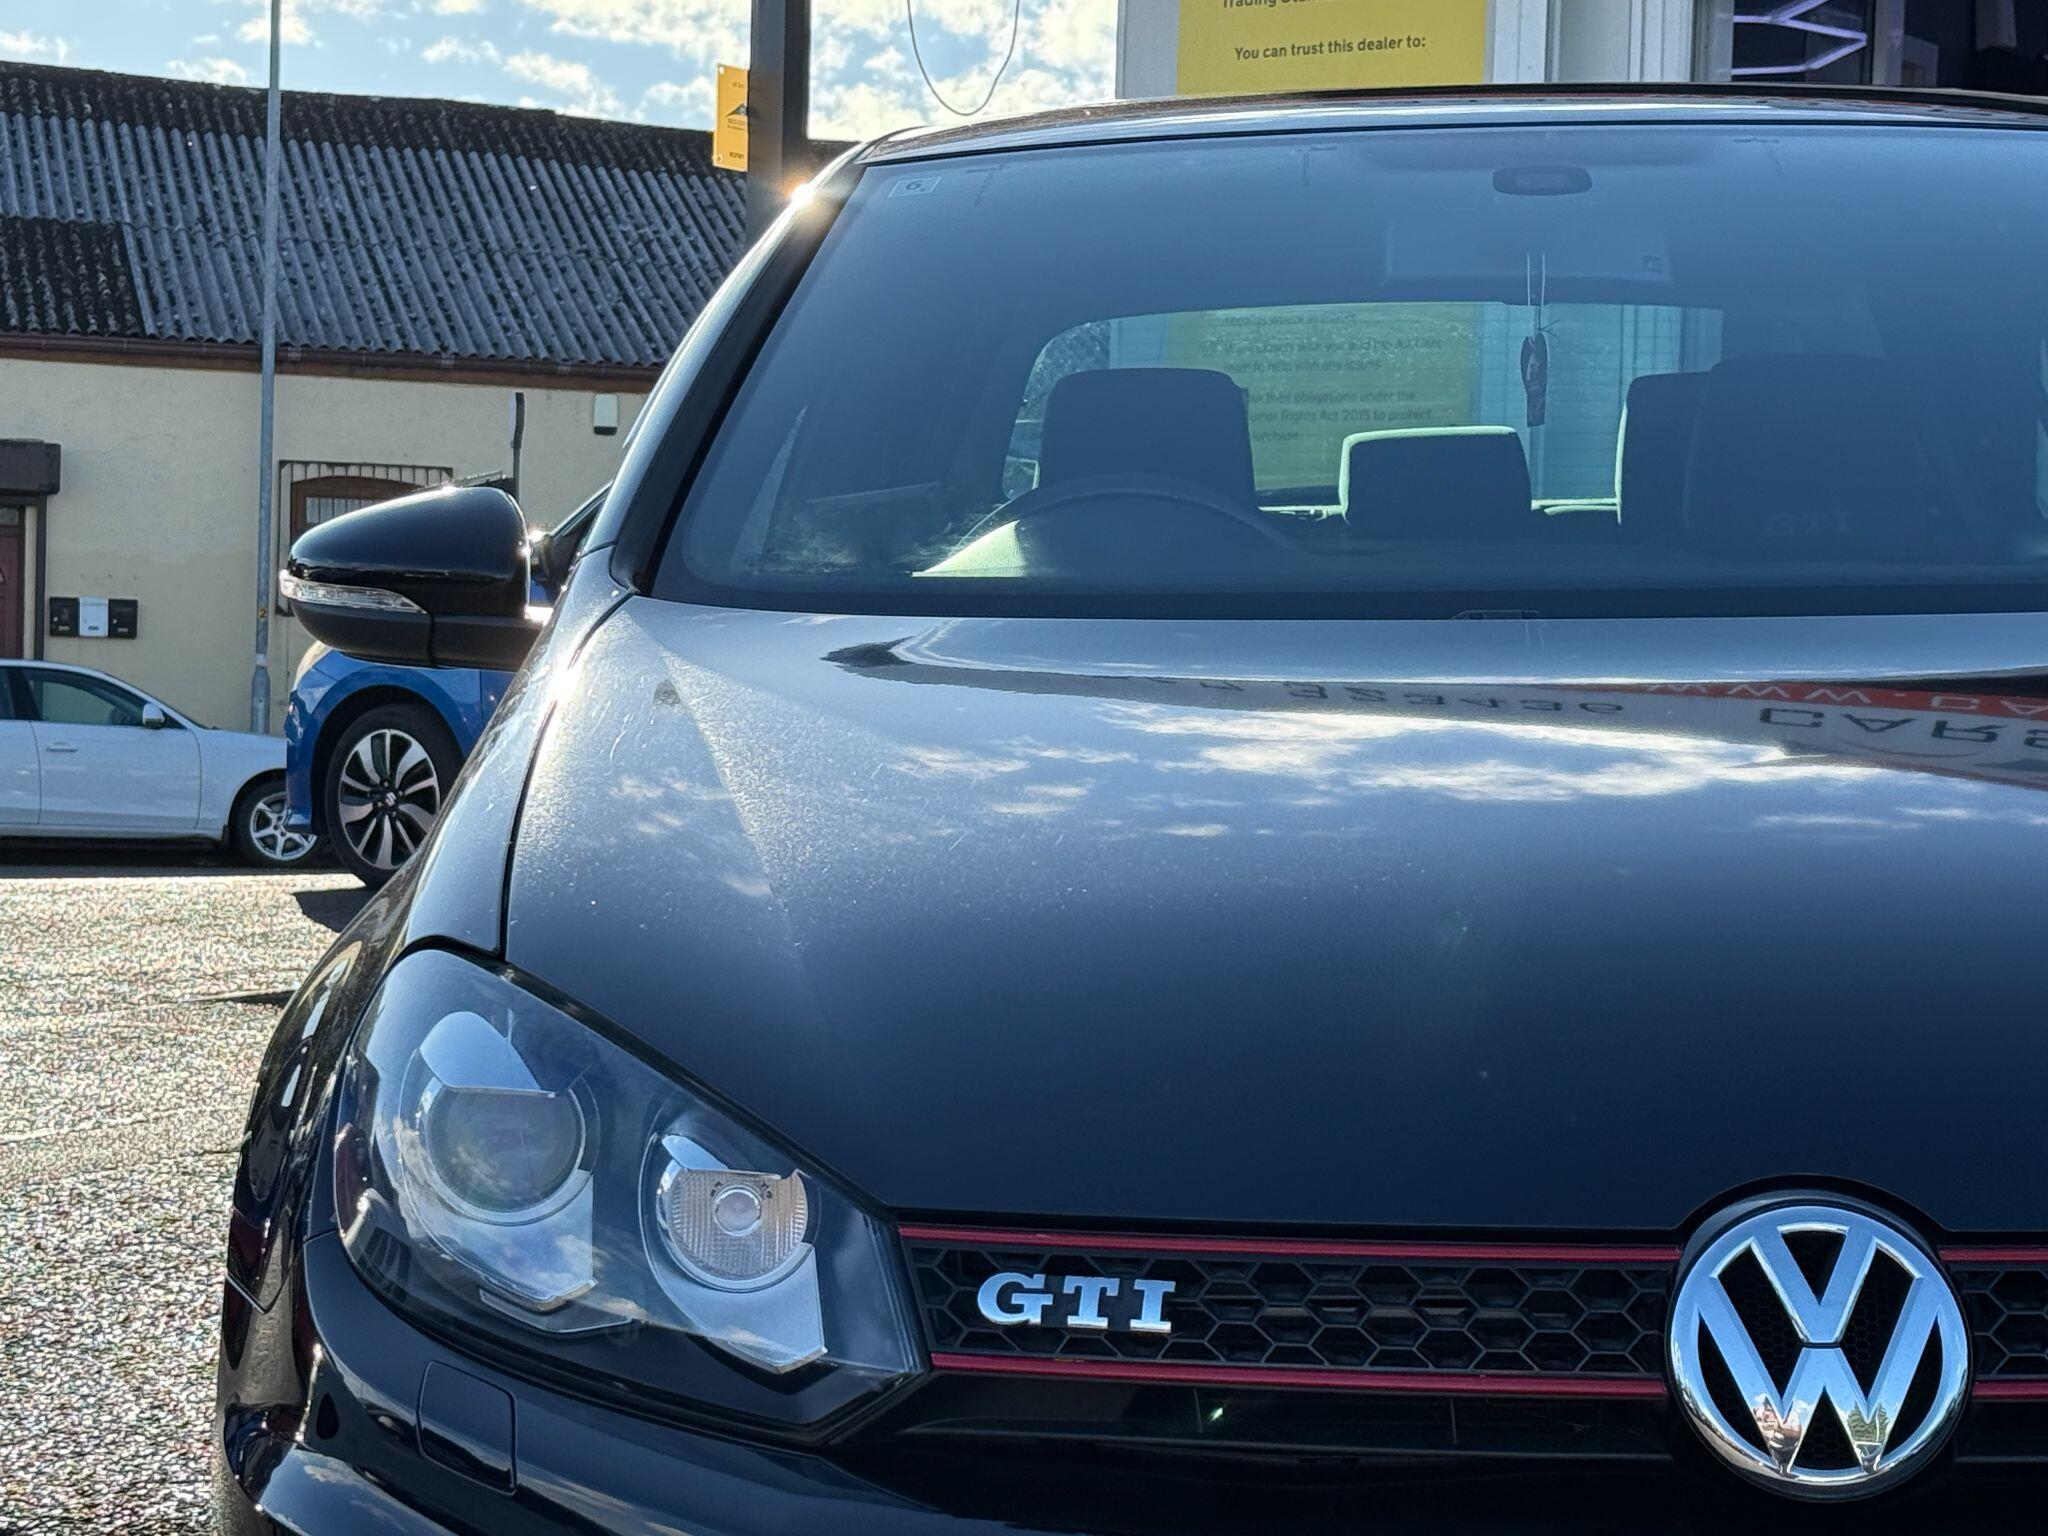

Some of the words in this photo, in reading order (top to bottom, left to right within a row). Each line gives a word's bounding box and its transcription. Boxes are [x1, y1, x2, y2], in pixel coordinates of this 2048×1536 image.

[1235, 47, 1260, 60] You
[1263, 46, 1287, 58] can
[1291, 41, 1323, 56] trust
[1328, 39, 1354, 53] this
[1357, 36, 1403, 51] dealer
[1406, 35, 1427, 48] to:
[1397, 391, 1415, 402] the
[1281, 409, 1317, 424] Rights
[1320, 410, 1339, 421] Act
[1342, 409, 1371, 421] 2015
[1373, 410, 1385, 421] to
[1388, 409, 1432, 424] protect
[977, 1272, 1176, 1333] GTI
